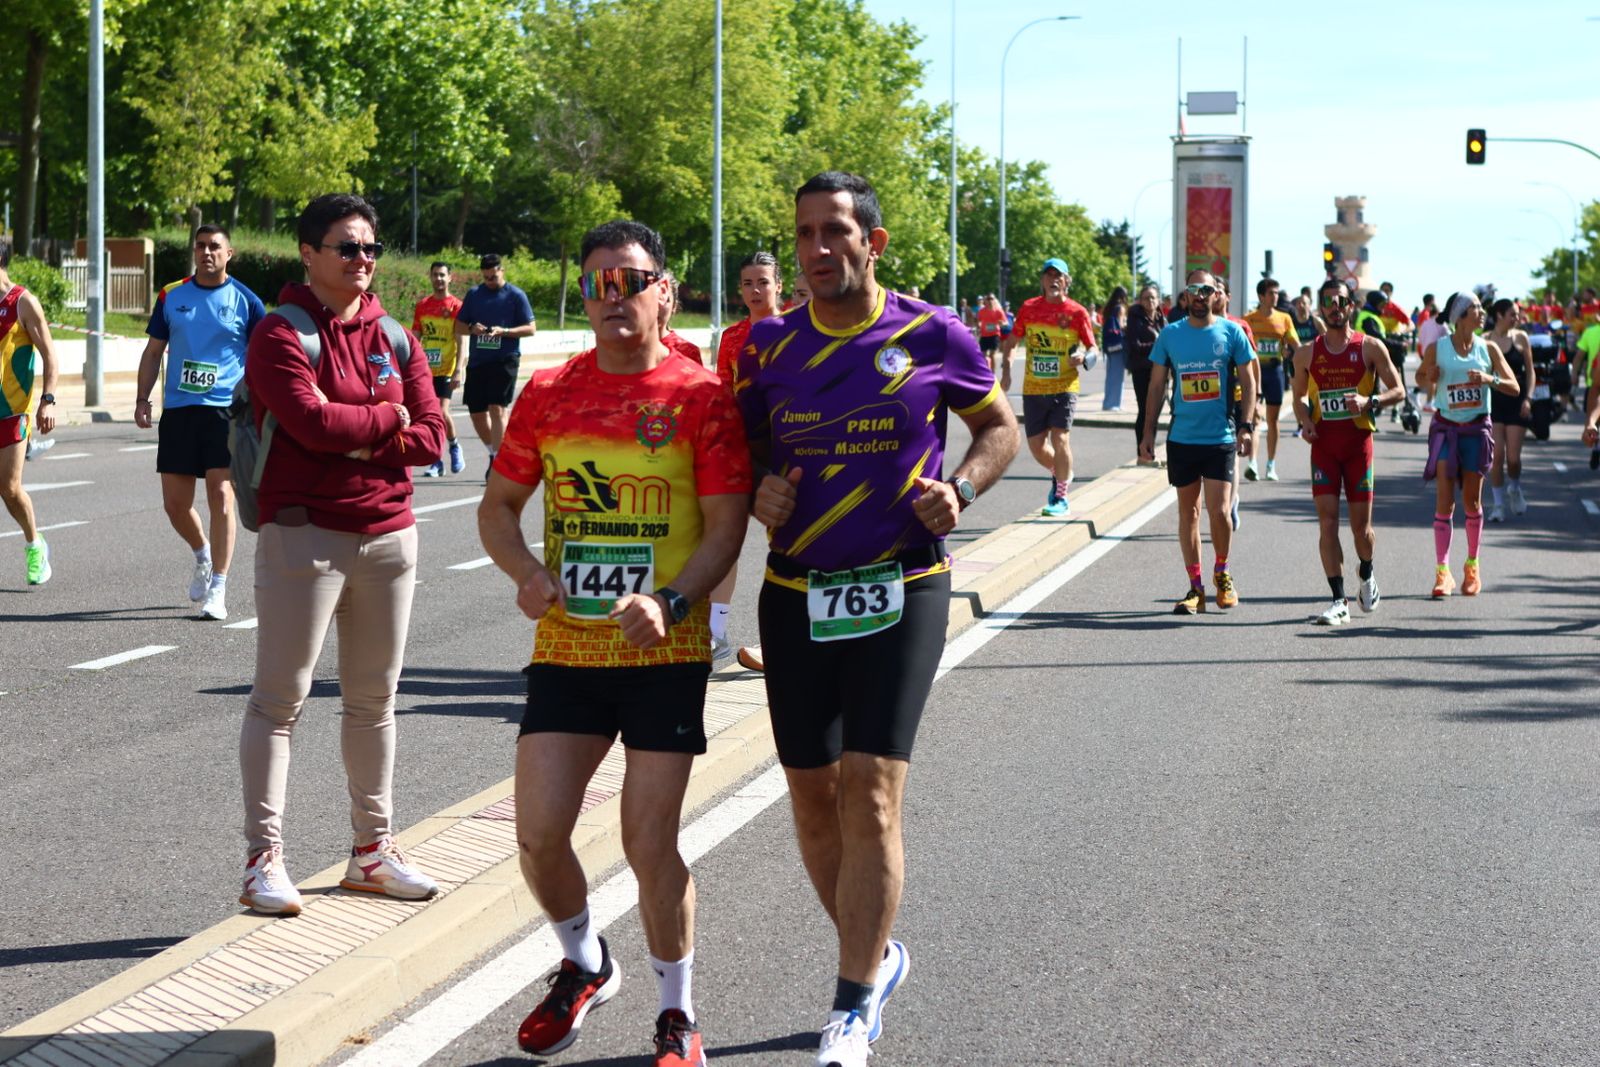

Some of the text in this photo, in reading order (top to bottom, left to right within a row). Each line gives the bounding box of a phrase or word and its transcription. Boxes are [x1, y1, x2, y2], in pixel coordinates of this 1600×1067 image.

[1034, 361, 1058, 372] 1054
[183, 369, 216, 386] 1649
[1191, 379, 1210, 393] 10
[1448, 388, 1482, 403] 1833
[1321, 397, 1348, 412] 101
[781, 410, 821, 424] Jamón
[847, 417, 895, 434] PRIM
[835, 439, 899, 455] Macotera
[580, 521, 638, 537] FERNANDO
[641, 522, 670, 539] 2026
[564, 564, 650, 597] 1447
[823, 584, 889, 618] 763
